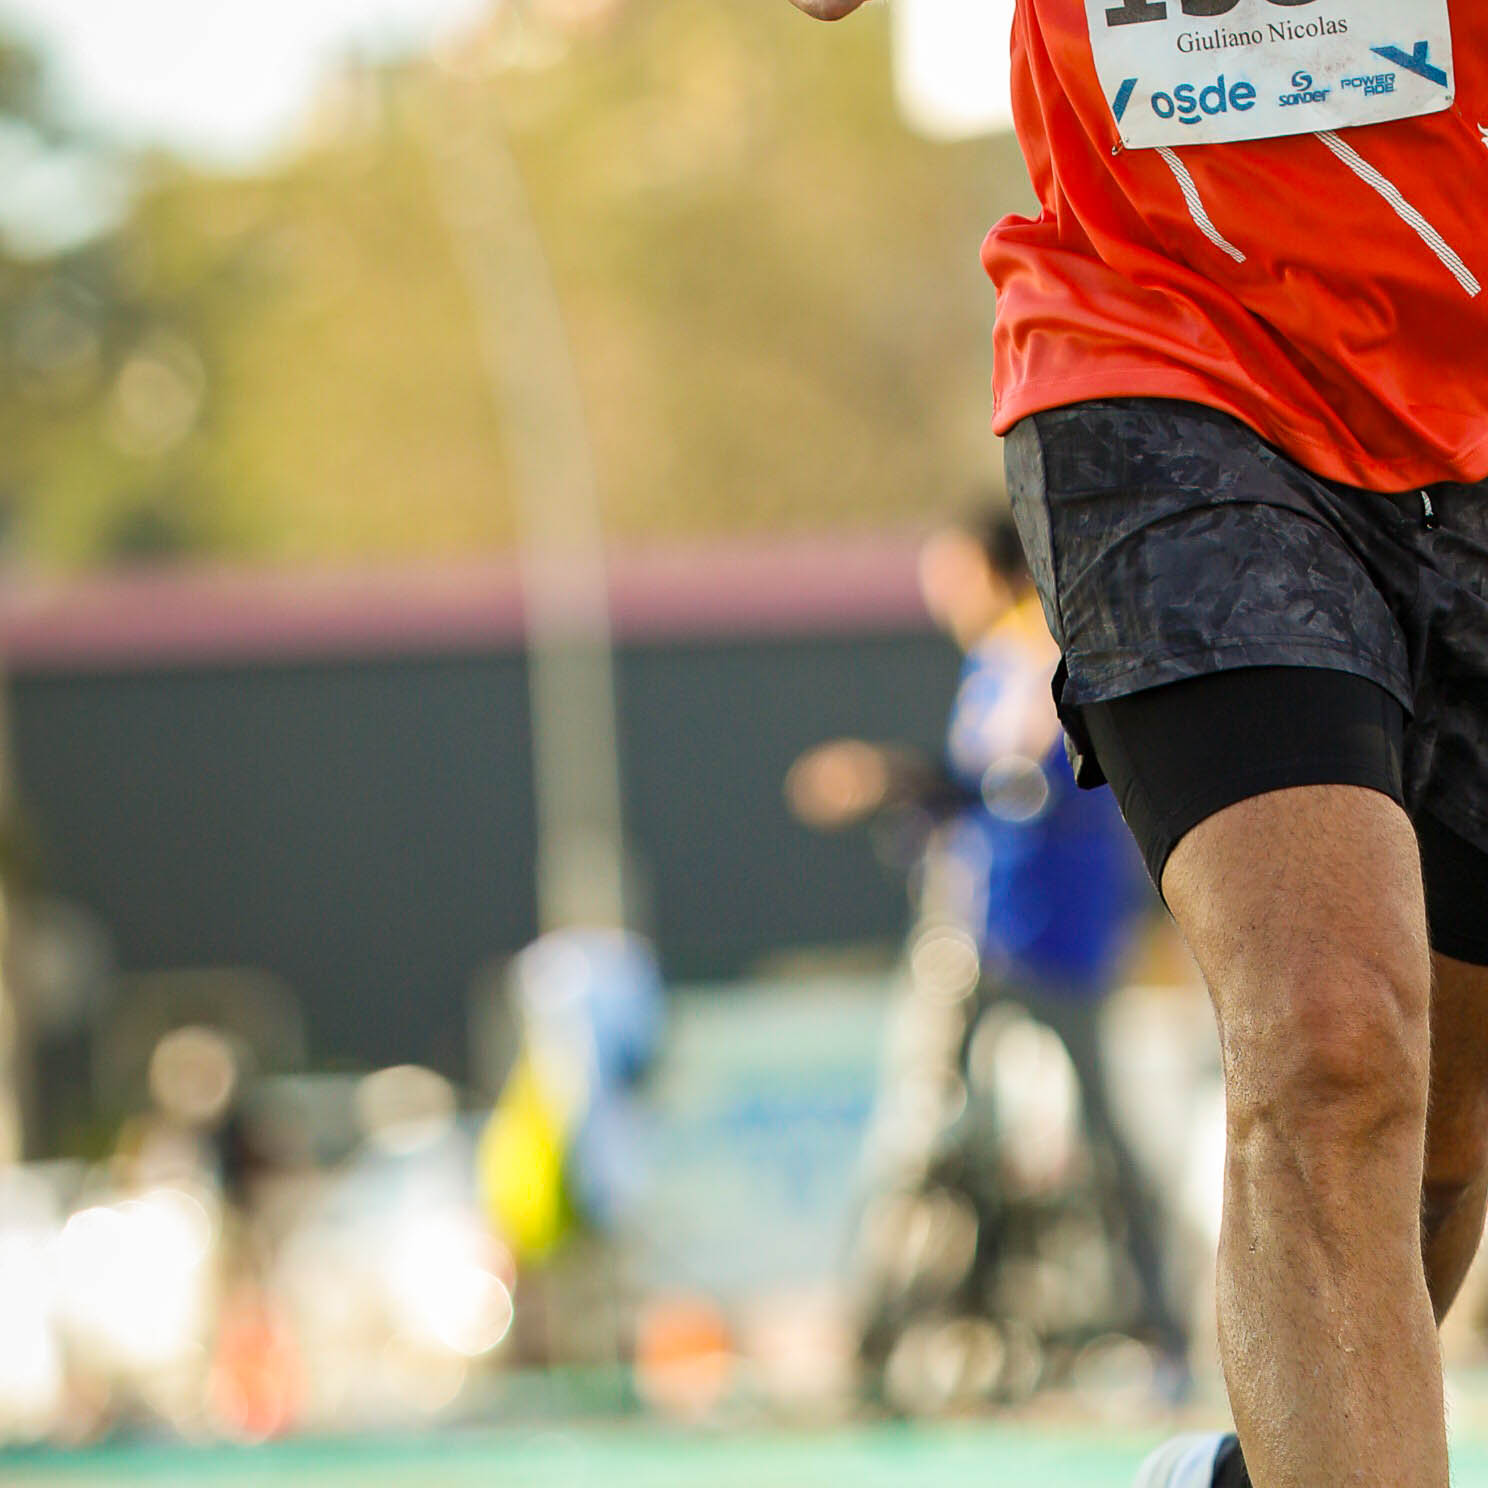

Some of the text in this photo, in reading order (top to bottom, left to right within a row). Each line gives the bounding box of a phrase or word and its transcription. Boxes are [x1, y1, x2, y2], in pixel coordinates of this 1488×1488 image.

[1176, 16, 1348, 53] Giuliano Nicolas
[1341, 73, 1395, 89] POWER
[1364, 84, 1394, 96] ADE
[1151, 73, 1256, 120] osde
